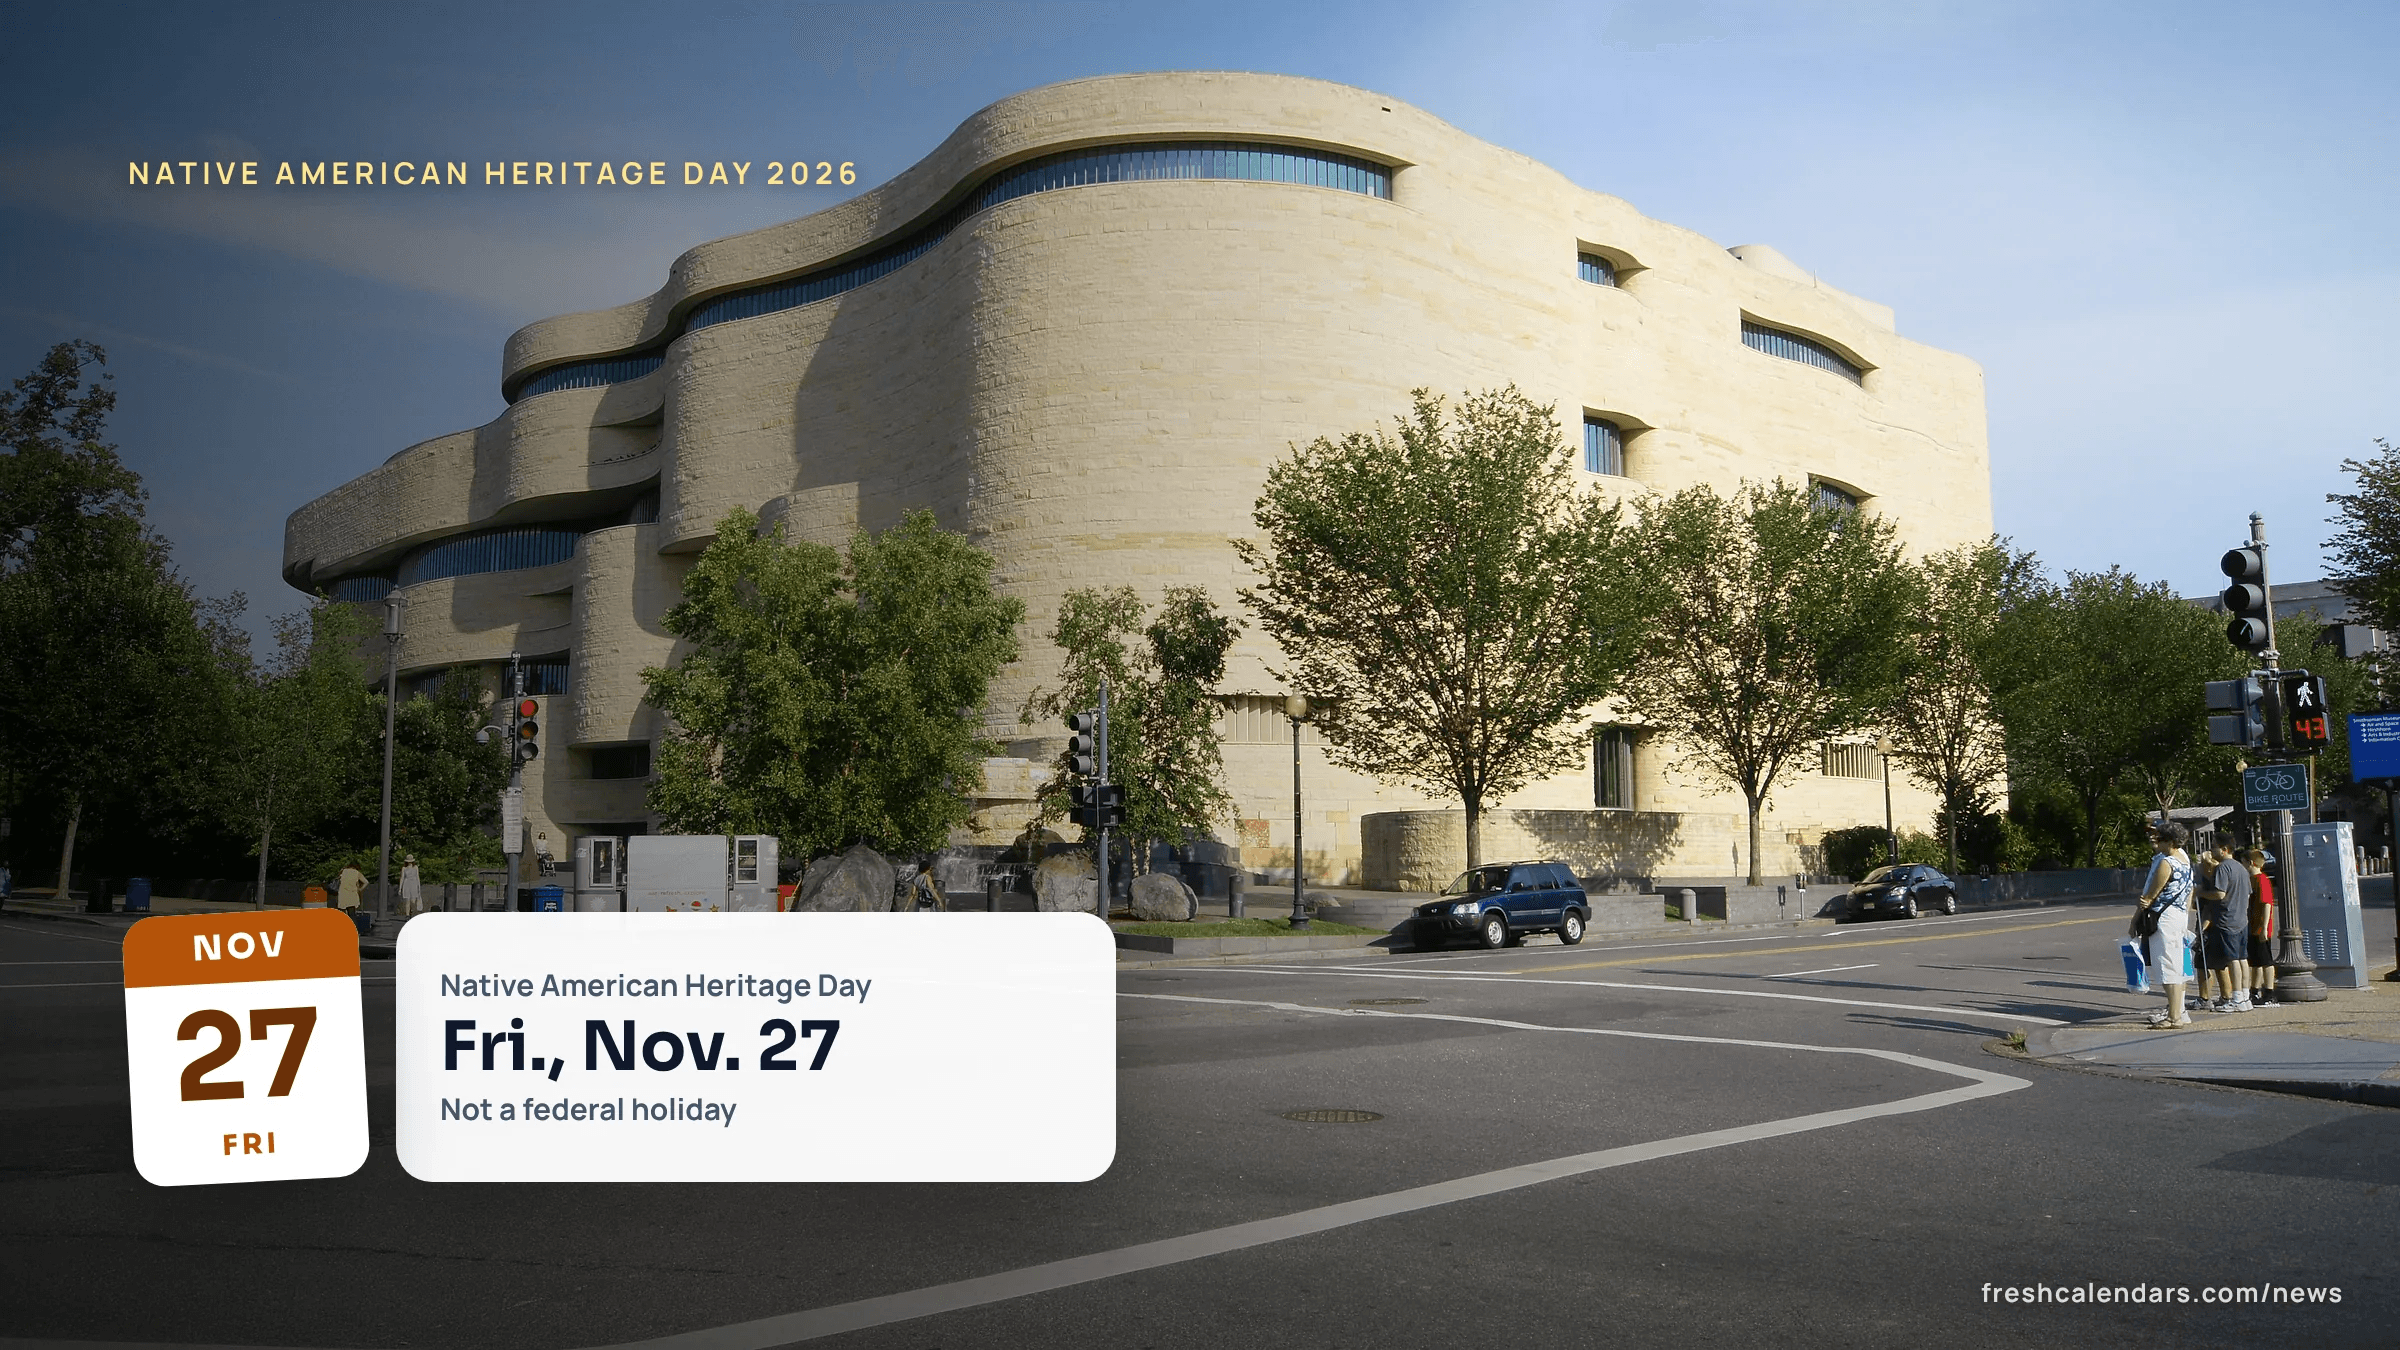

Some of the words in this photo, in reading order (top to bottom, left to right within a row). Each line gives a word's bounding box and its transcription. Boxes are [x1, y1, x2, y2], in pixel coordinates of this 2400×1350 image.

[2296, 717, 2326, 739] 43
[2248, 795, 2269, 804] BIKE
[2271, 792, 2305, 803] ROUTE
